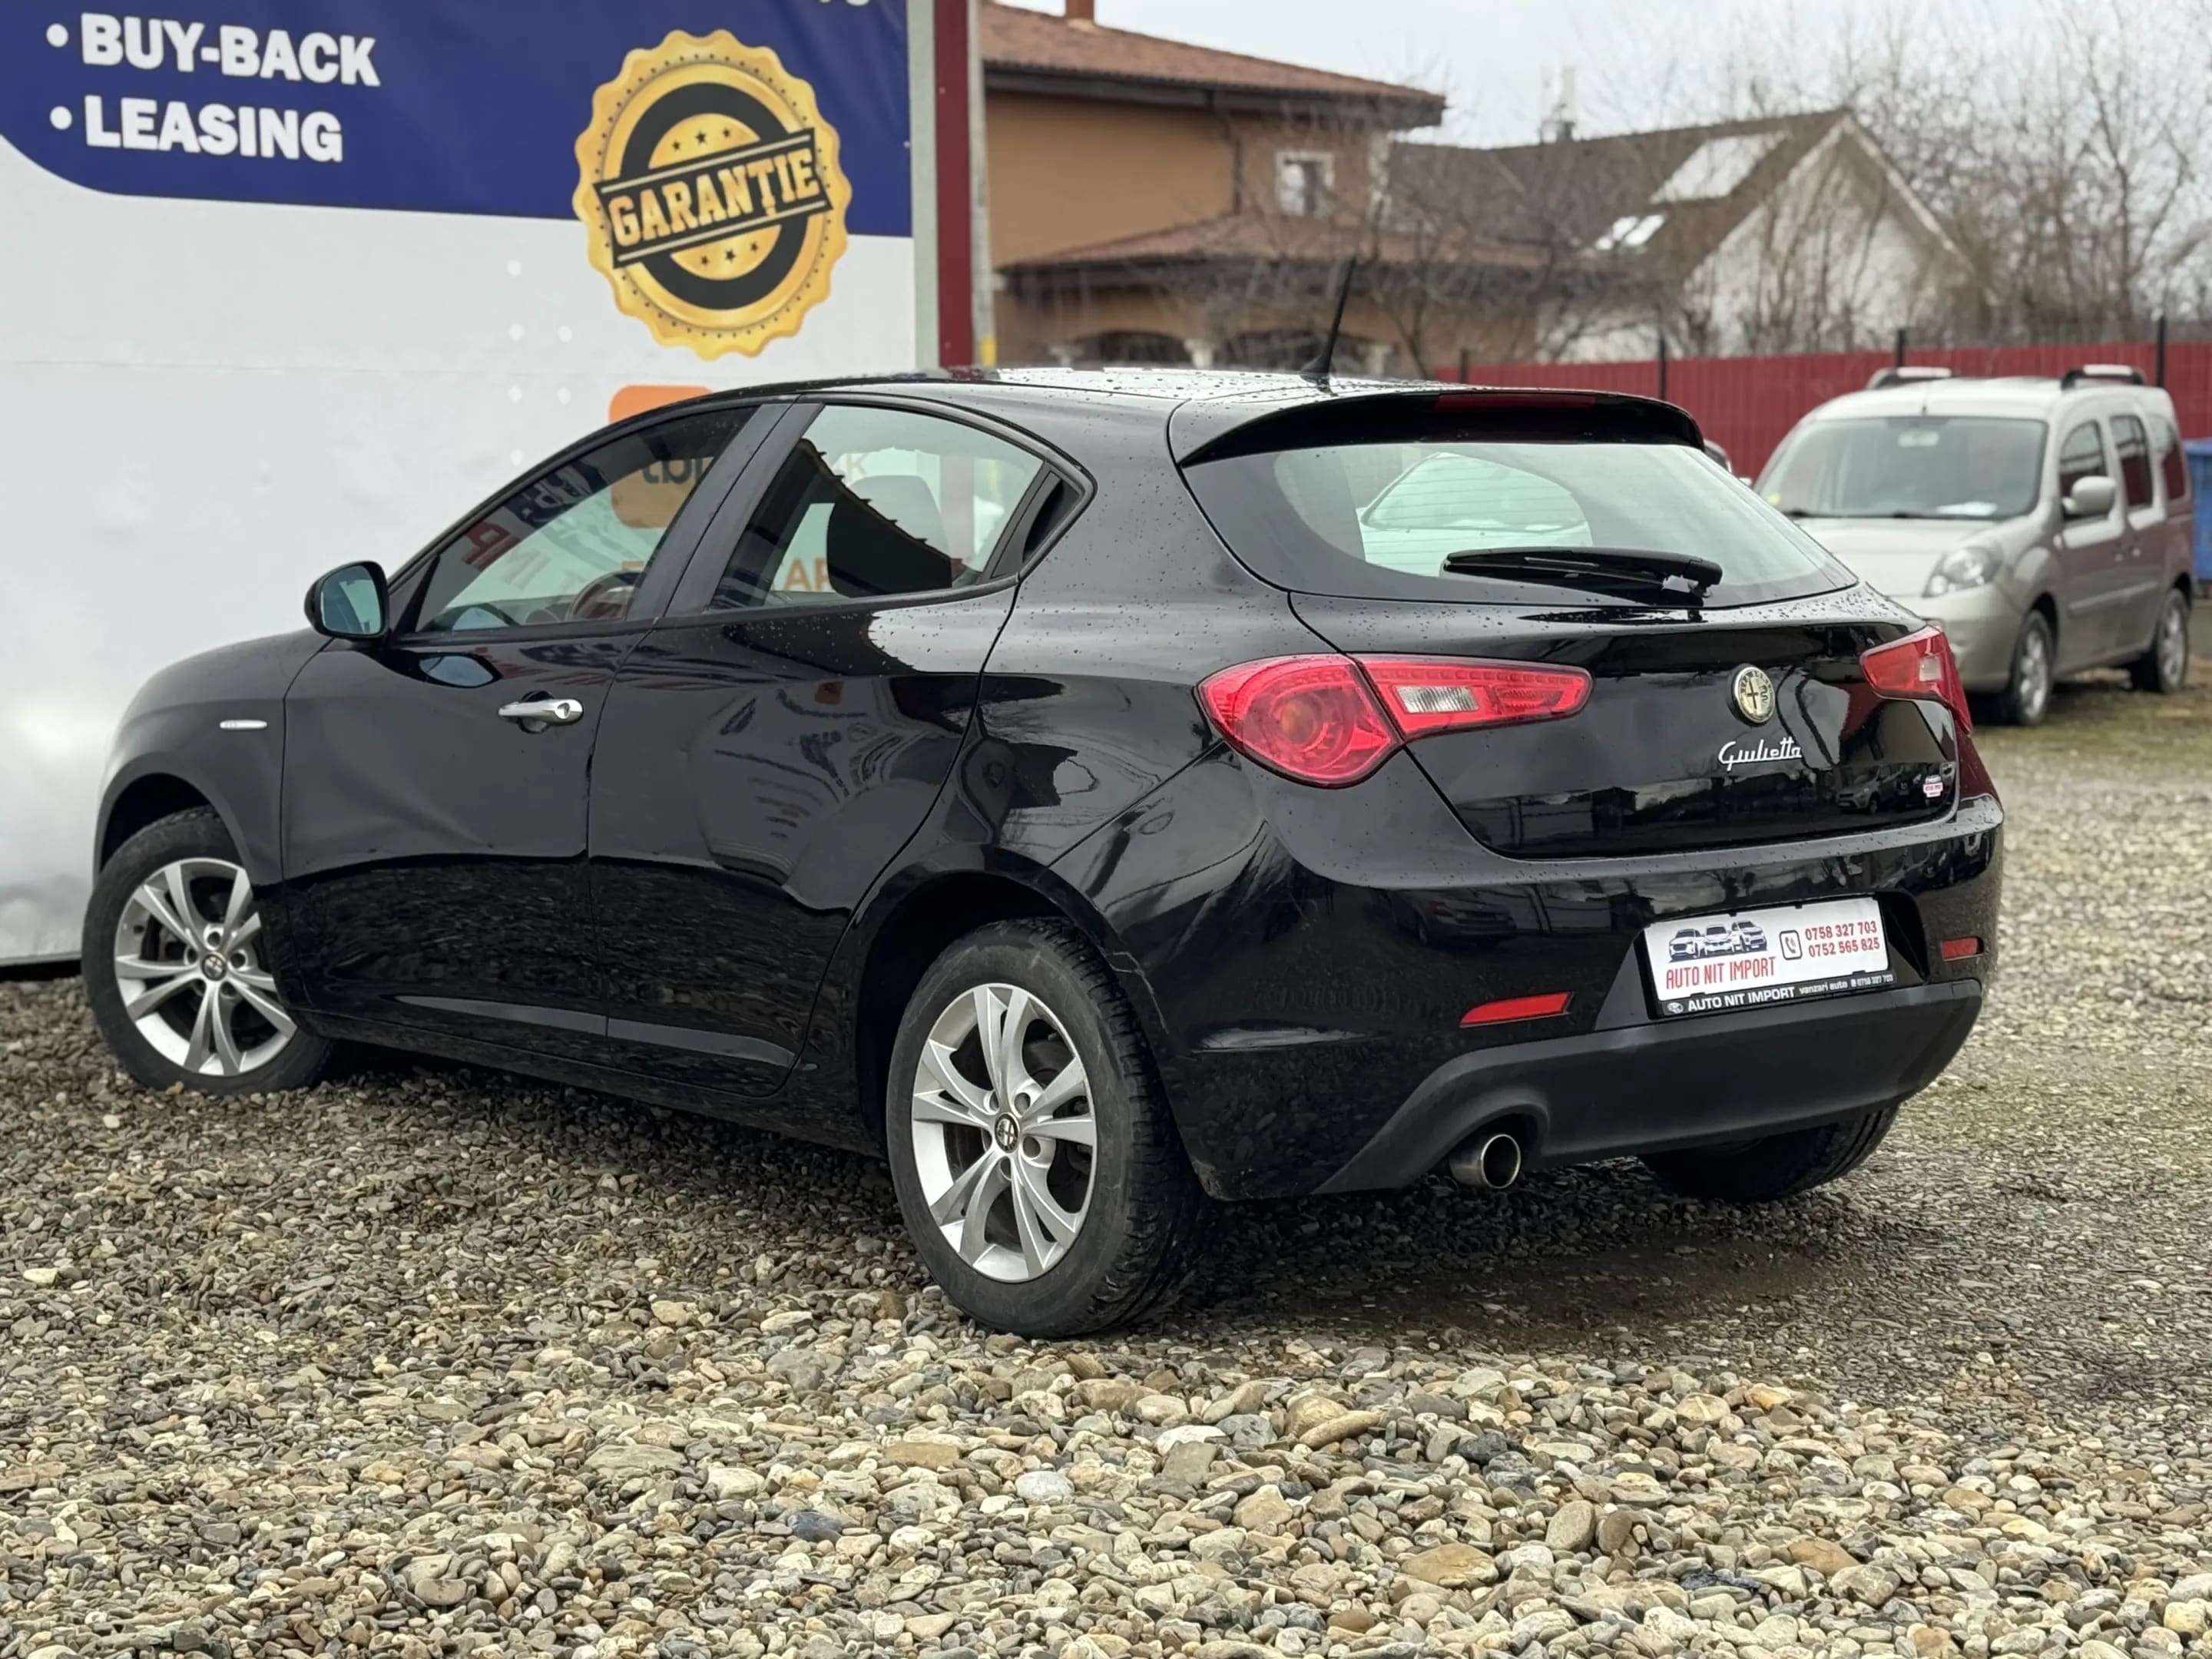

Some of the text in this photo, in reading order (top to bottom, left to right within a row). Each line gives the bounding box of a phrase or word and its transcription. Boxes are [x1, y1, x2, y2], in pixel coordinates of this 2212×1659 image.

[81, 12, 381, 87] BUY-BACK
[84, 94, 343, 163] LEASING
[608, 147, 822, 248] GARANȚIE
[1717, 737, 1803, 771] Giulietta
[1805, 921, 1878, 941] 0758 327 703
[1808, 937, 1880, 958] 0752 565 825
[1665, 956, 1777, 989] AUTO NIT IMPORT
[1687, 997, 1722, 1012] AUTO
[1724, 993, 1746, 1007] NIT
[1747, 986, 1796, 1004] IMPORT
[1799, 982, 1829, 995] vanzari
[1830, 981, 1848, 990] auto
